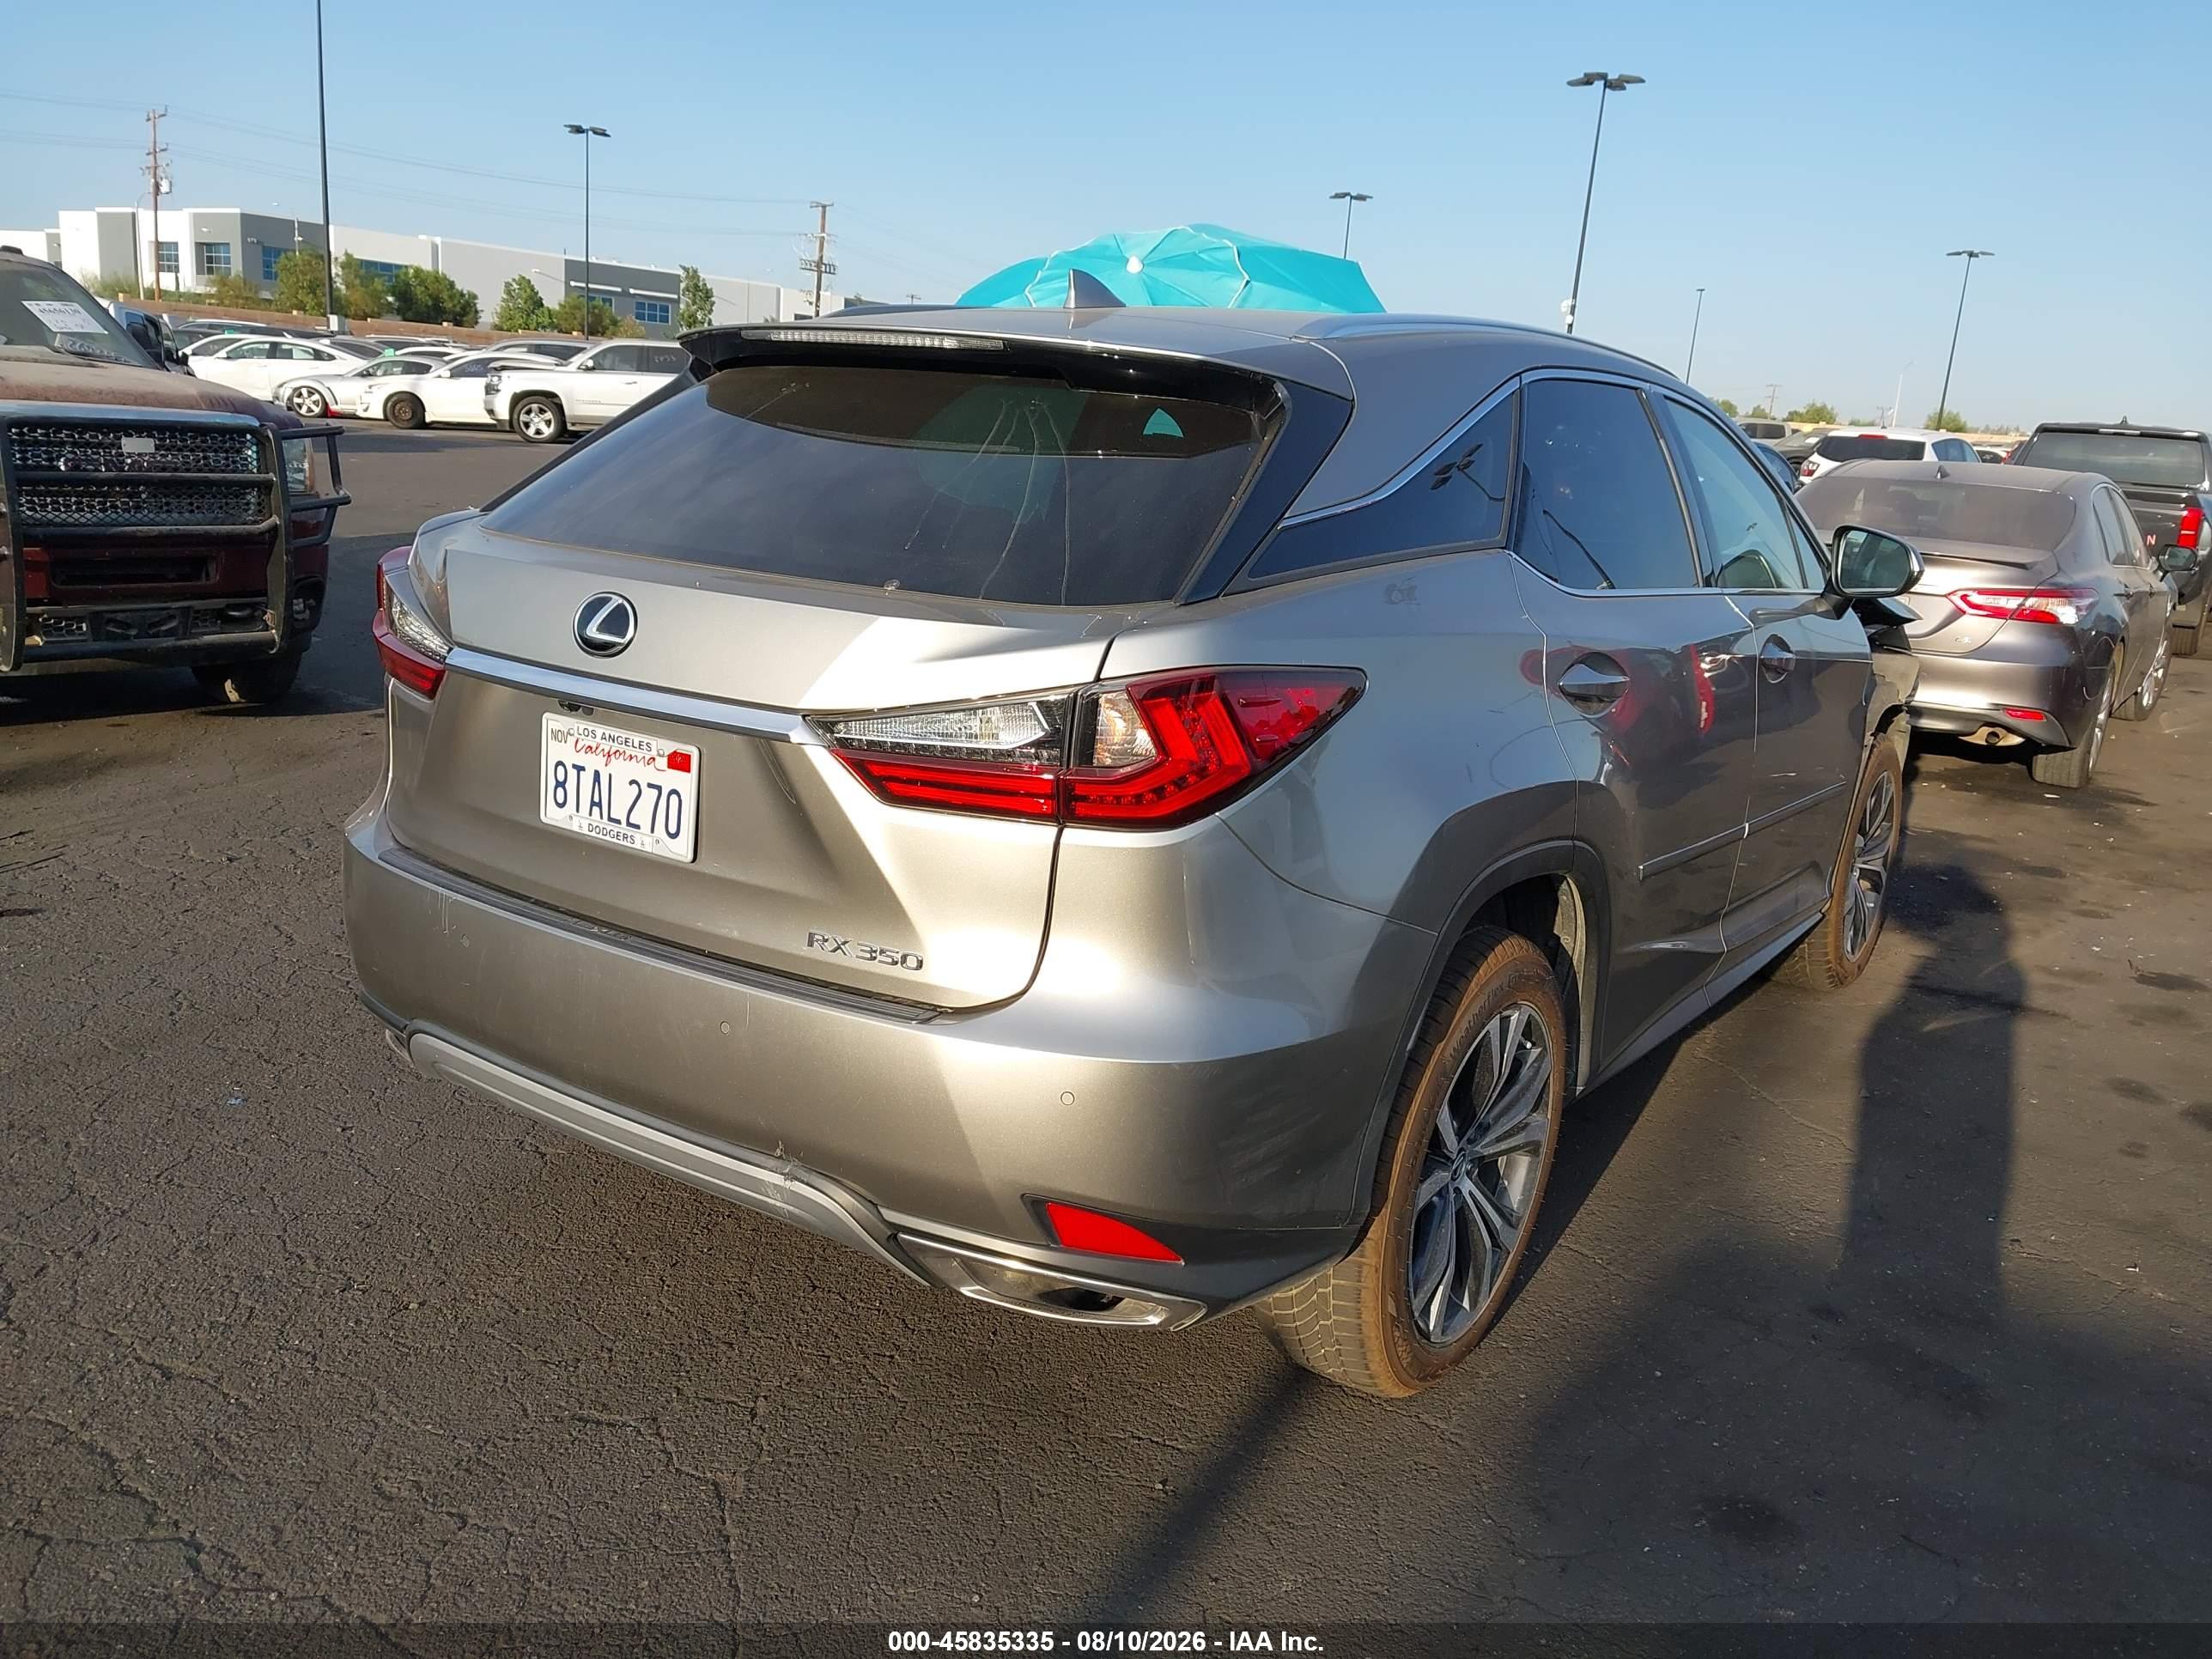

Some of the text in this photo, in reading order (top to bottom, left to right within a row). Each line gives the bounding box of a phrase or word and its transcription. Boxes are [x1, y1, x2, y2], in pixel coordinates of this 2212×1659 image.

[550, 727, 568, 744] NOV
[576, 726, 653, 752] LOS ANGELES
[574, 738, 666, 771] California
[553, 760, 683, 840] 8TAL270
[587, 823, 635, 845] DODGERS
[806, 931, 925, 971] RX 350
